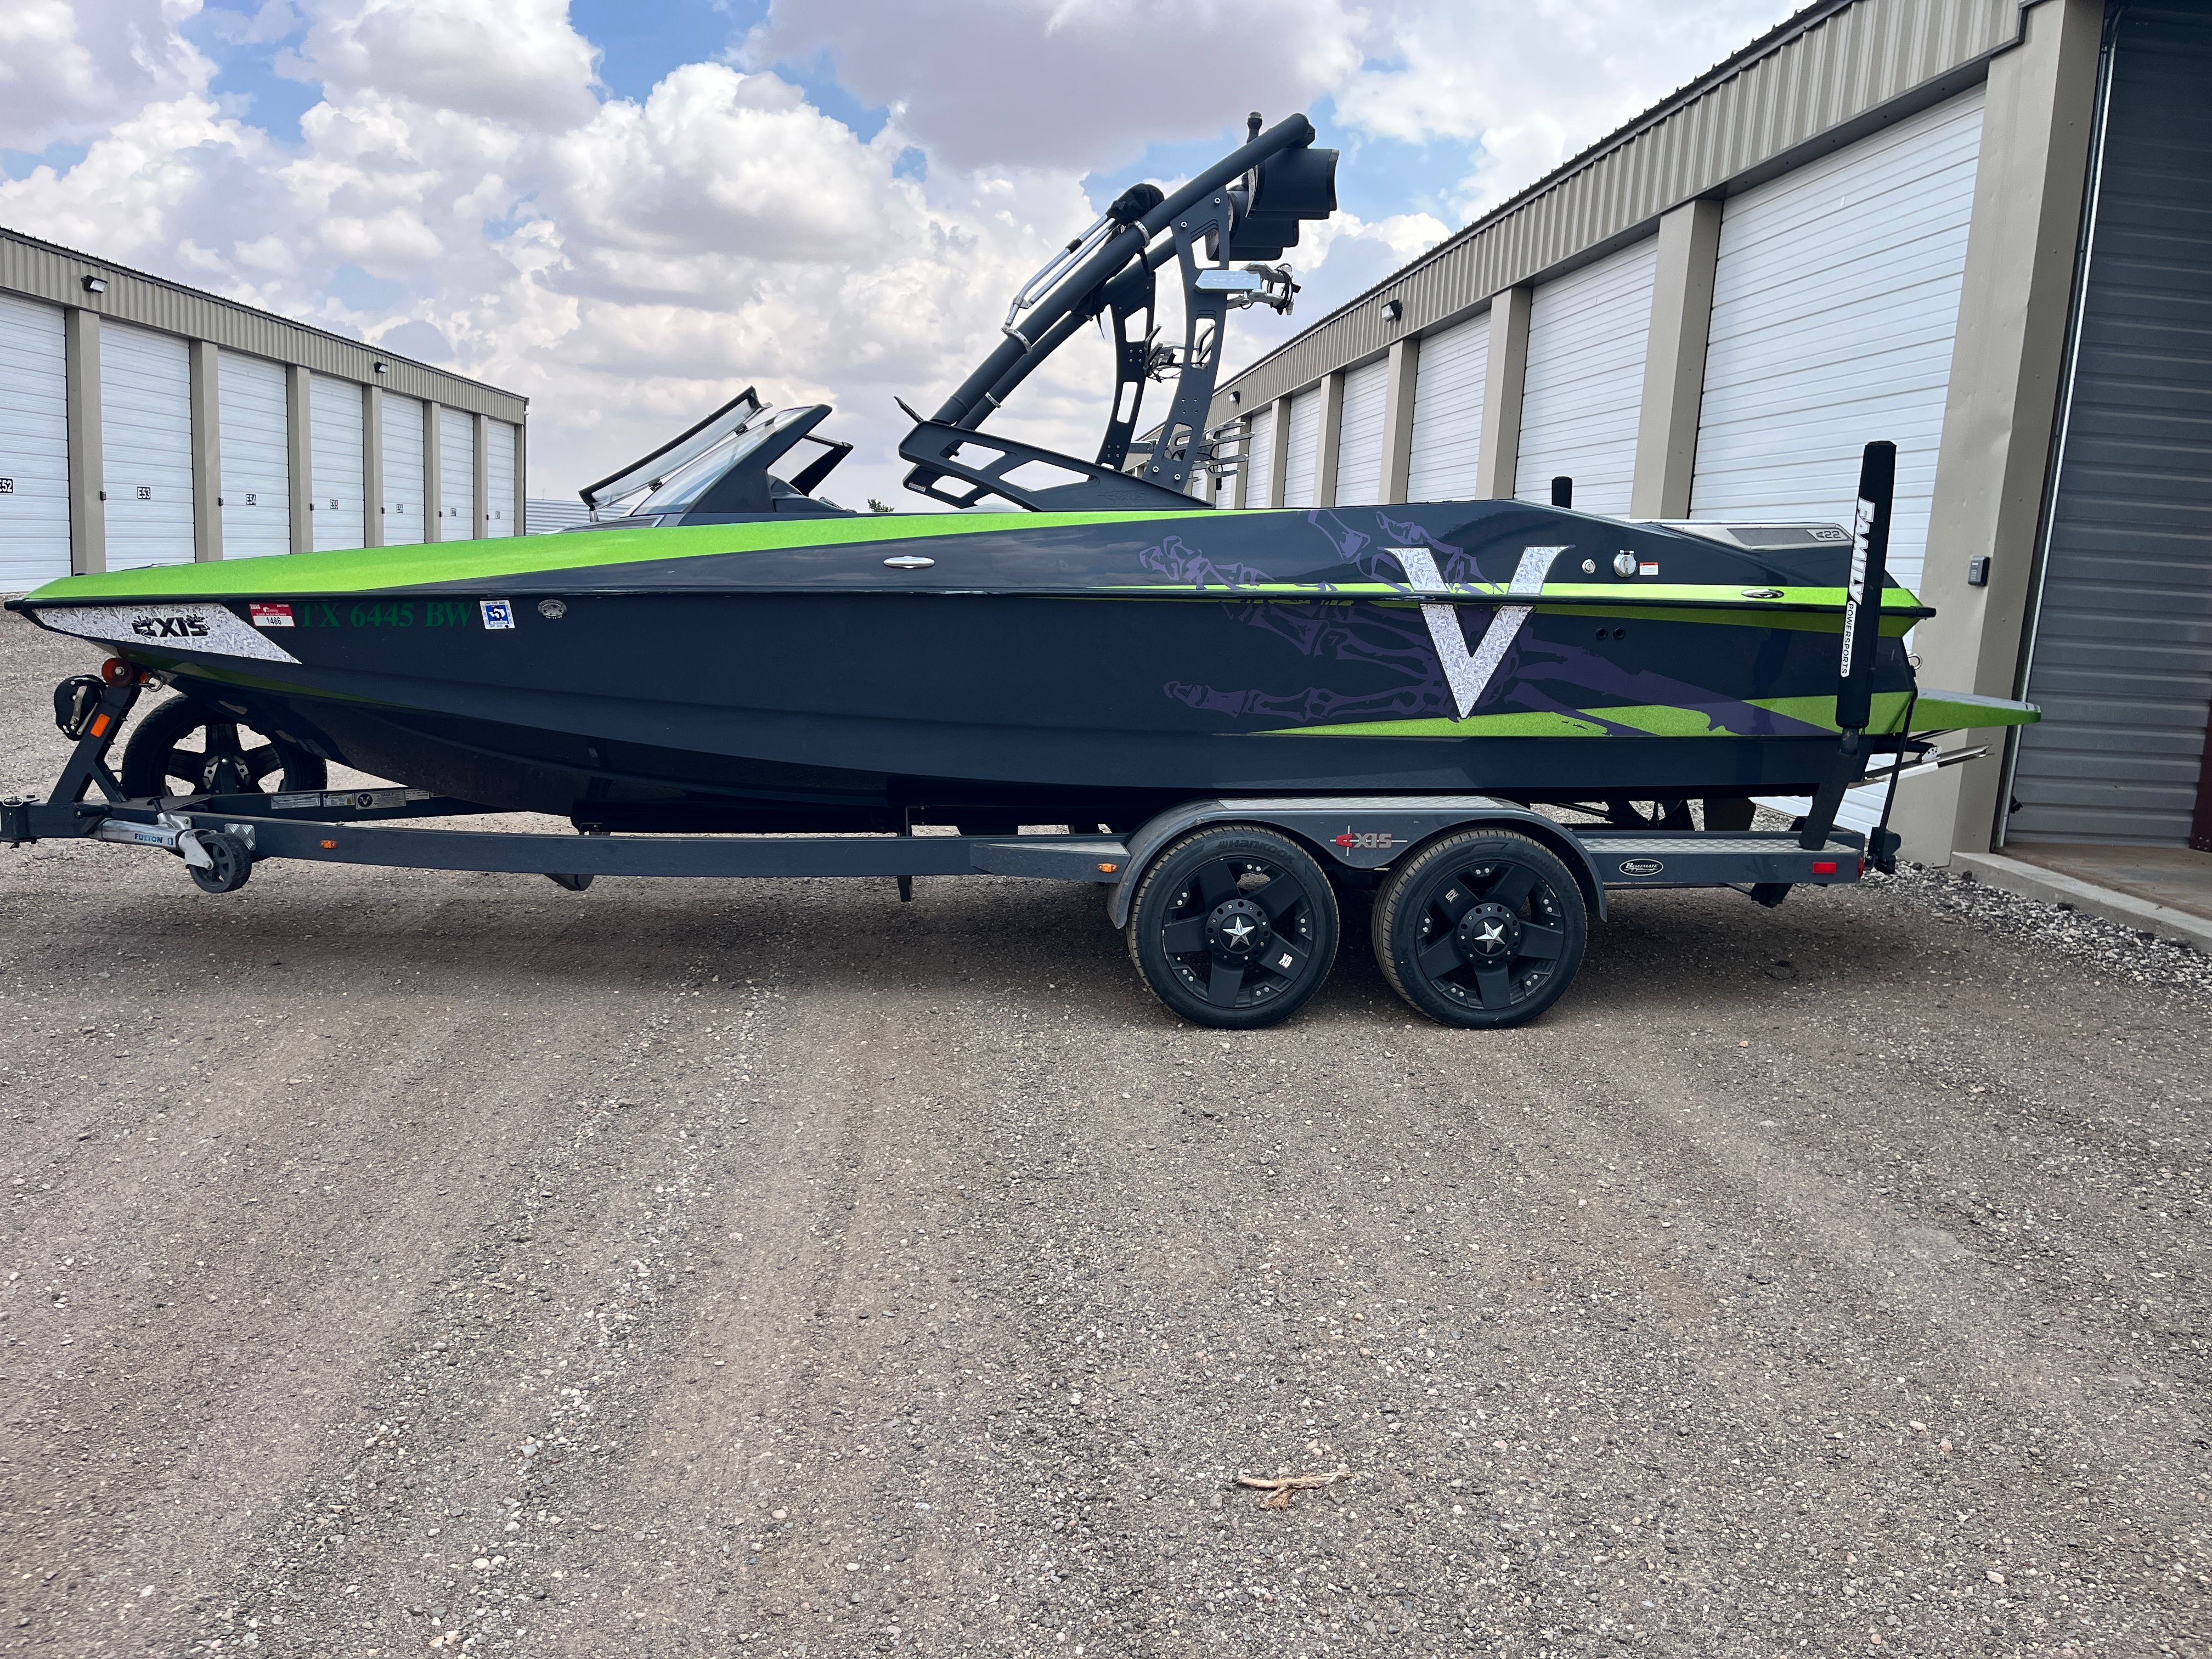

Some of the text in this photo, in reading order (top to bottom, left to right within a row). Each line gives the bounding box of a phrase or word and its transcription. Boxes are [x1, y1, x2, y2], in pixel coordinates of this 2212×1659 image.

[138, 488, 150, 498] E53
[247, 494, 256, 504] E54
[1815, 531, 1841, 539] A22
[1849, 496, 1875, 605] FAMILY
[297, 602, 341, 627] TX
[350, 602, 415, 628] 6445
[424, 601, 475, 627] BW
[266, 617, 282, 625] 1486
[1842, 603, 1854, 674] POWERSPORTS
[134, 833, 163, 843] FULTON
[1335, 833, 1392, 848] AXIS
[1278, 953, 1293, 968] XD
